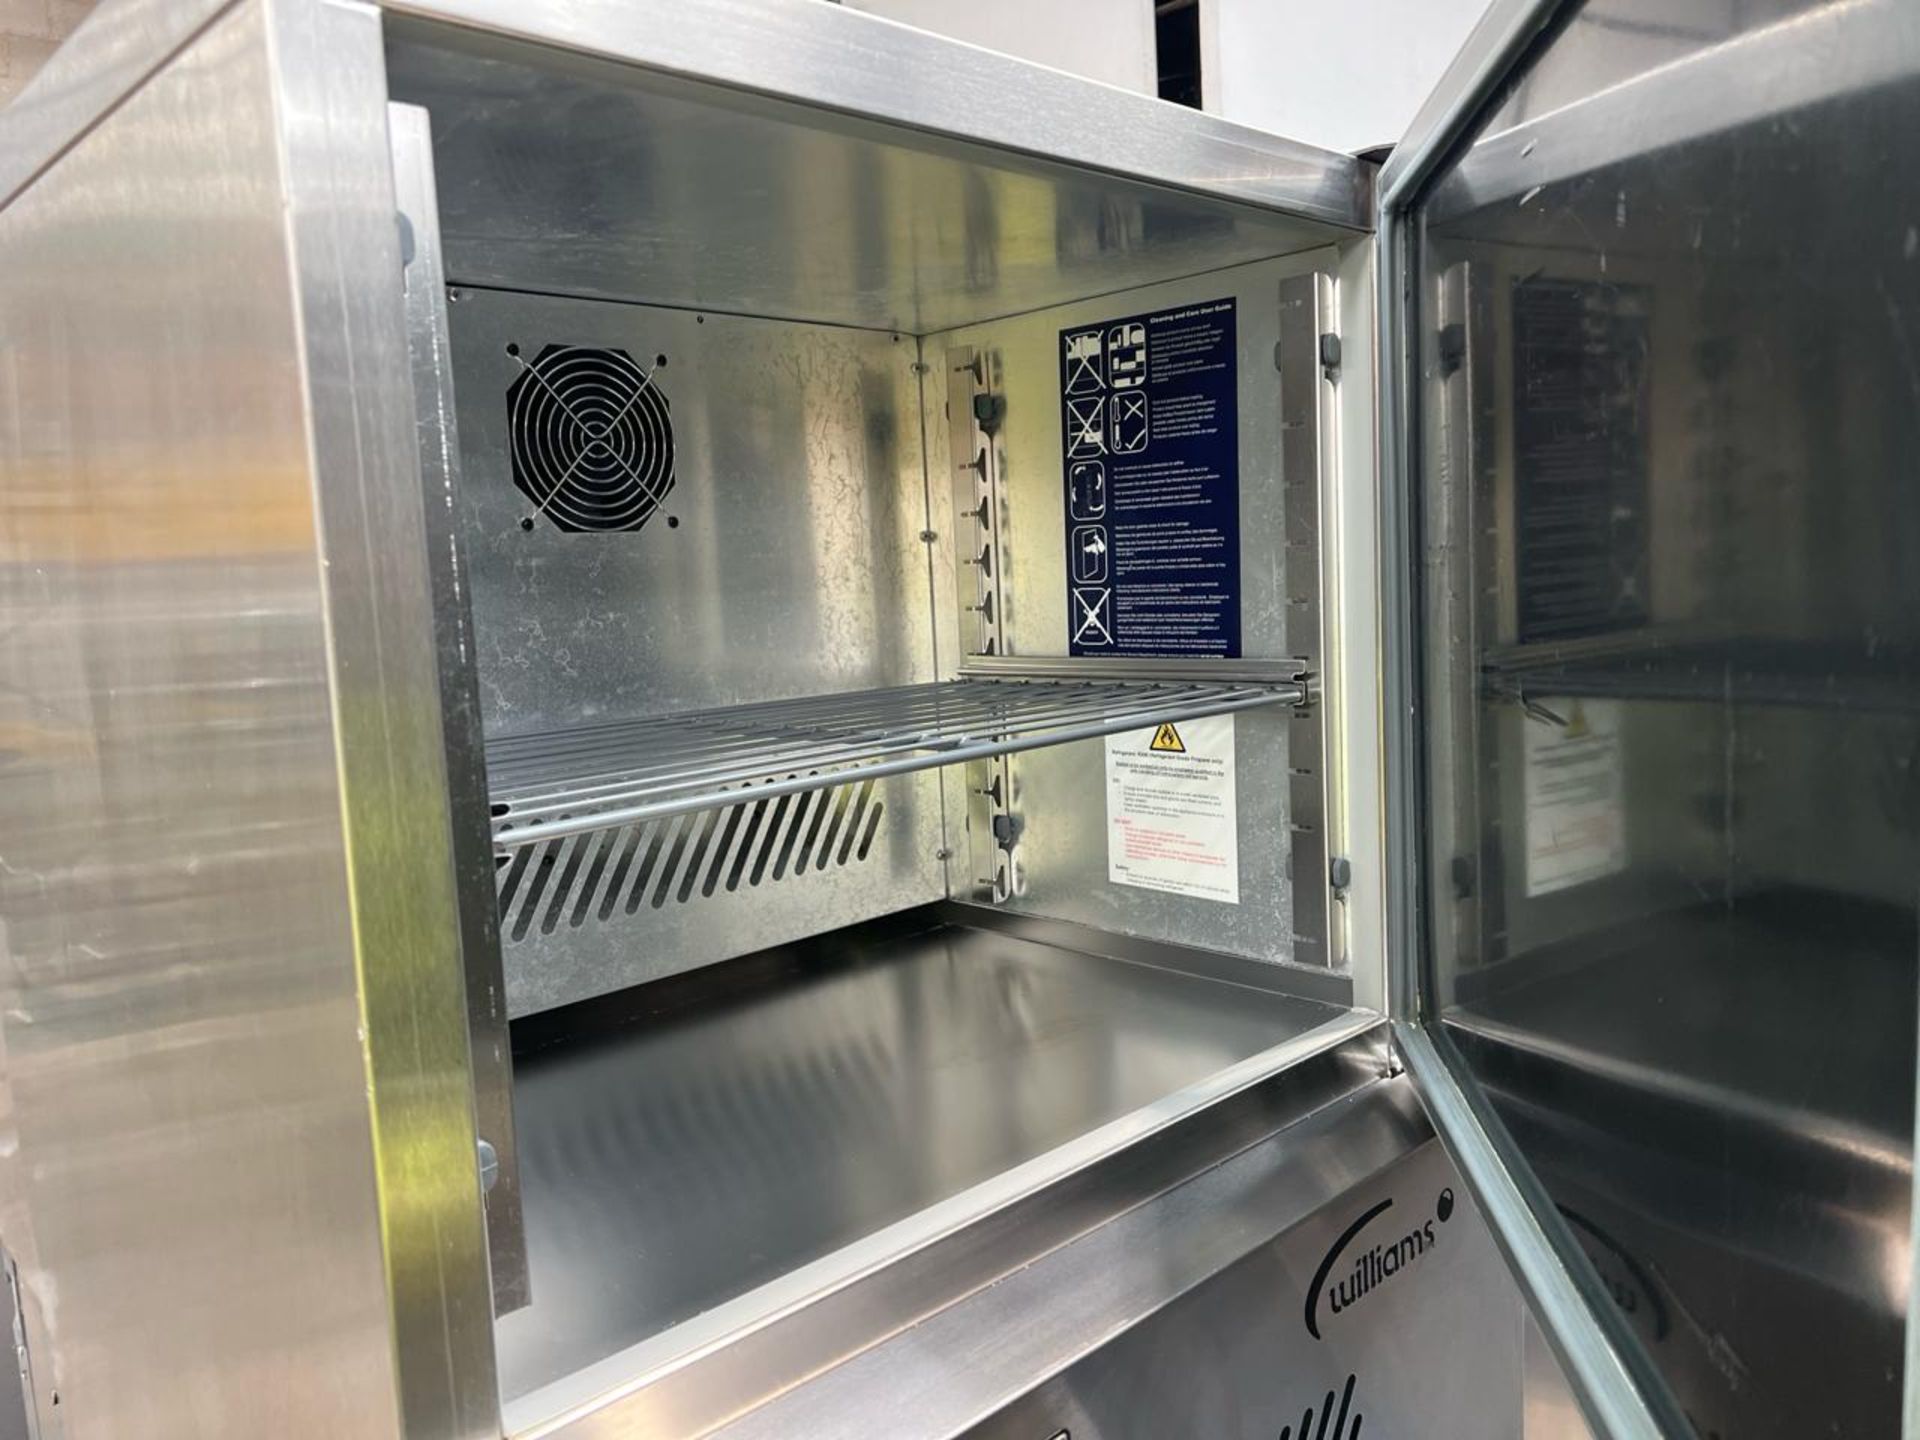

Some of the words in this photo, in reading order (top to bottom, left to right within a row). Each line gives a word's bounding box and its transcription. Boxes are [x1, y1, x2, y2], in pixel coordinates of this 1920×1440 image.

[1150, 314, 1174, 324] Cleaning
[1175, 311, 1186, 319] and
[1186, 309, 1199, 317] Care
[1214, 304, 1232, 312] Guide
[1329, 1219, 1435, 1314] williams
